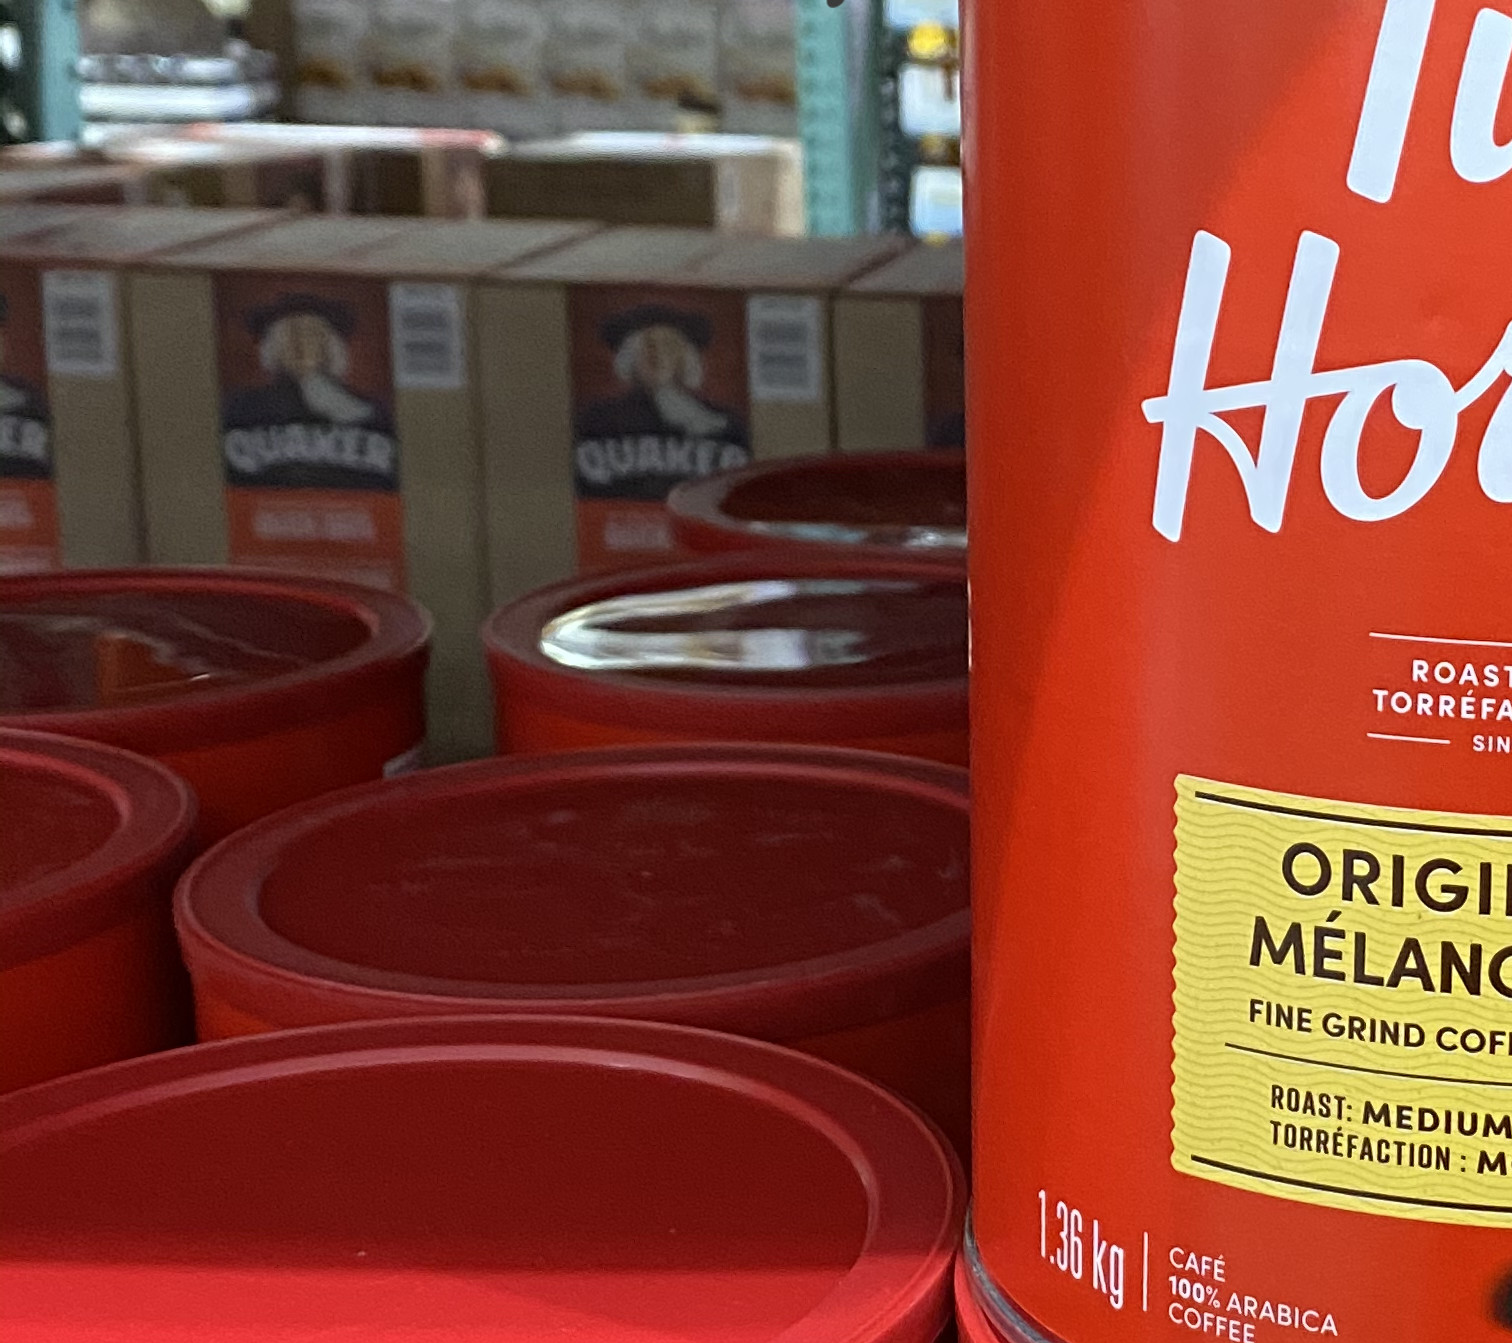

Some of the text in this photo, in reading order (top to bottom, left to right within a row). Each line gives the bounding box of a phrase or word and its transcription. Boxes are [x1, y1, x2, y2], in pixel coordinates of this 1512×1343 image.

[223, 427, 396, 472] QUAKER
[1249, 998, 1313, 1033] FINE
[1322, 1012, 1426, 1048] GRIND
[1271, 1084, 1512, 1140] ROAST: MEDIUM
[1270, 1120, 1451, 1171] TORRÉFACTION
[1038, 1189, 1124, 1310] 1.36 kg
[1168, 1246, 1226, 1283] CAFÉ
[1168, 1275, 1339, 1337] 100% ARABICA
